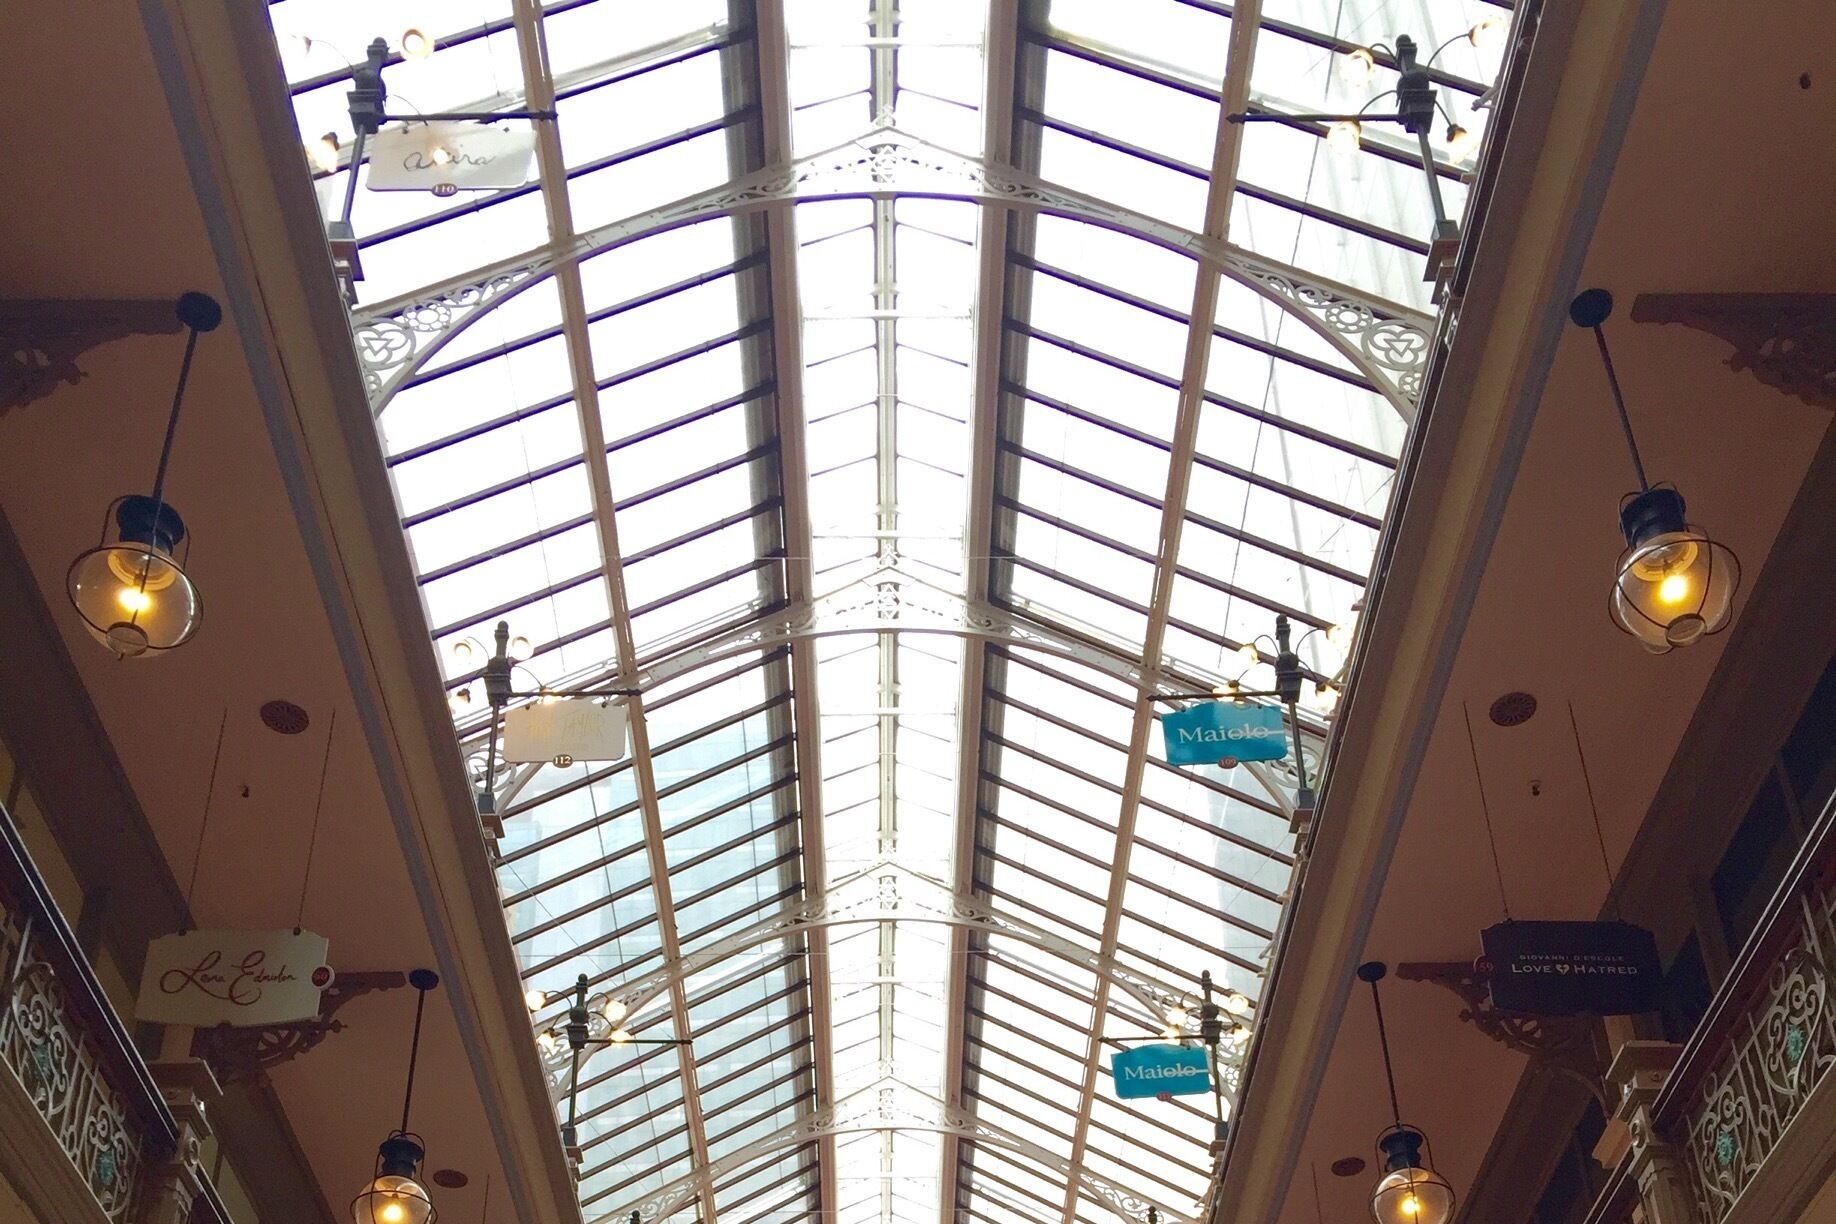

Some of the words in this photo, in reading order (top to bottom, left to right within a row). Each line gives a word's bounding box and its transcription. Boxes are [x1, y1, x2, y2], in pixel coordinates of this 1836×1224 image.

[1177, 723, 1270, 744] Maiolo
[554, 755, 572, 765] 112
[1511, 963, 1551, 974] LOVE
[1574, 963, 1638, 975] HATRED
[1124, 1063, 1196, 1081] Maiolo
